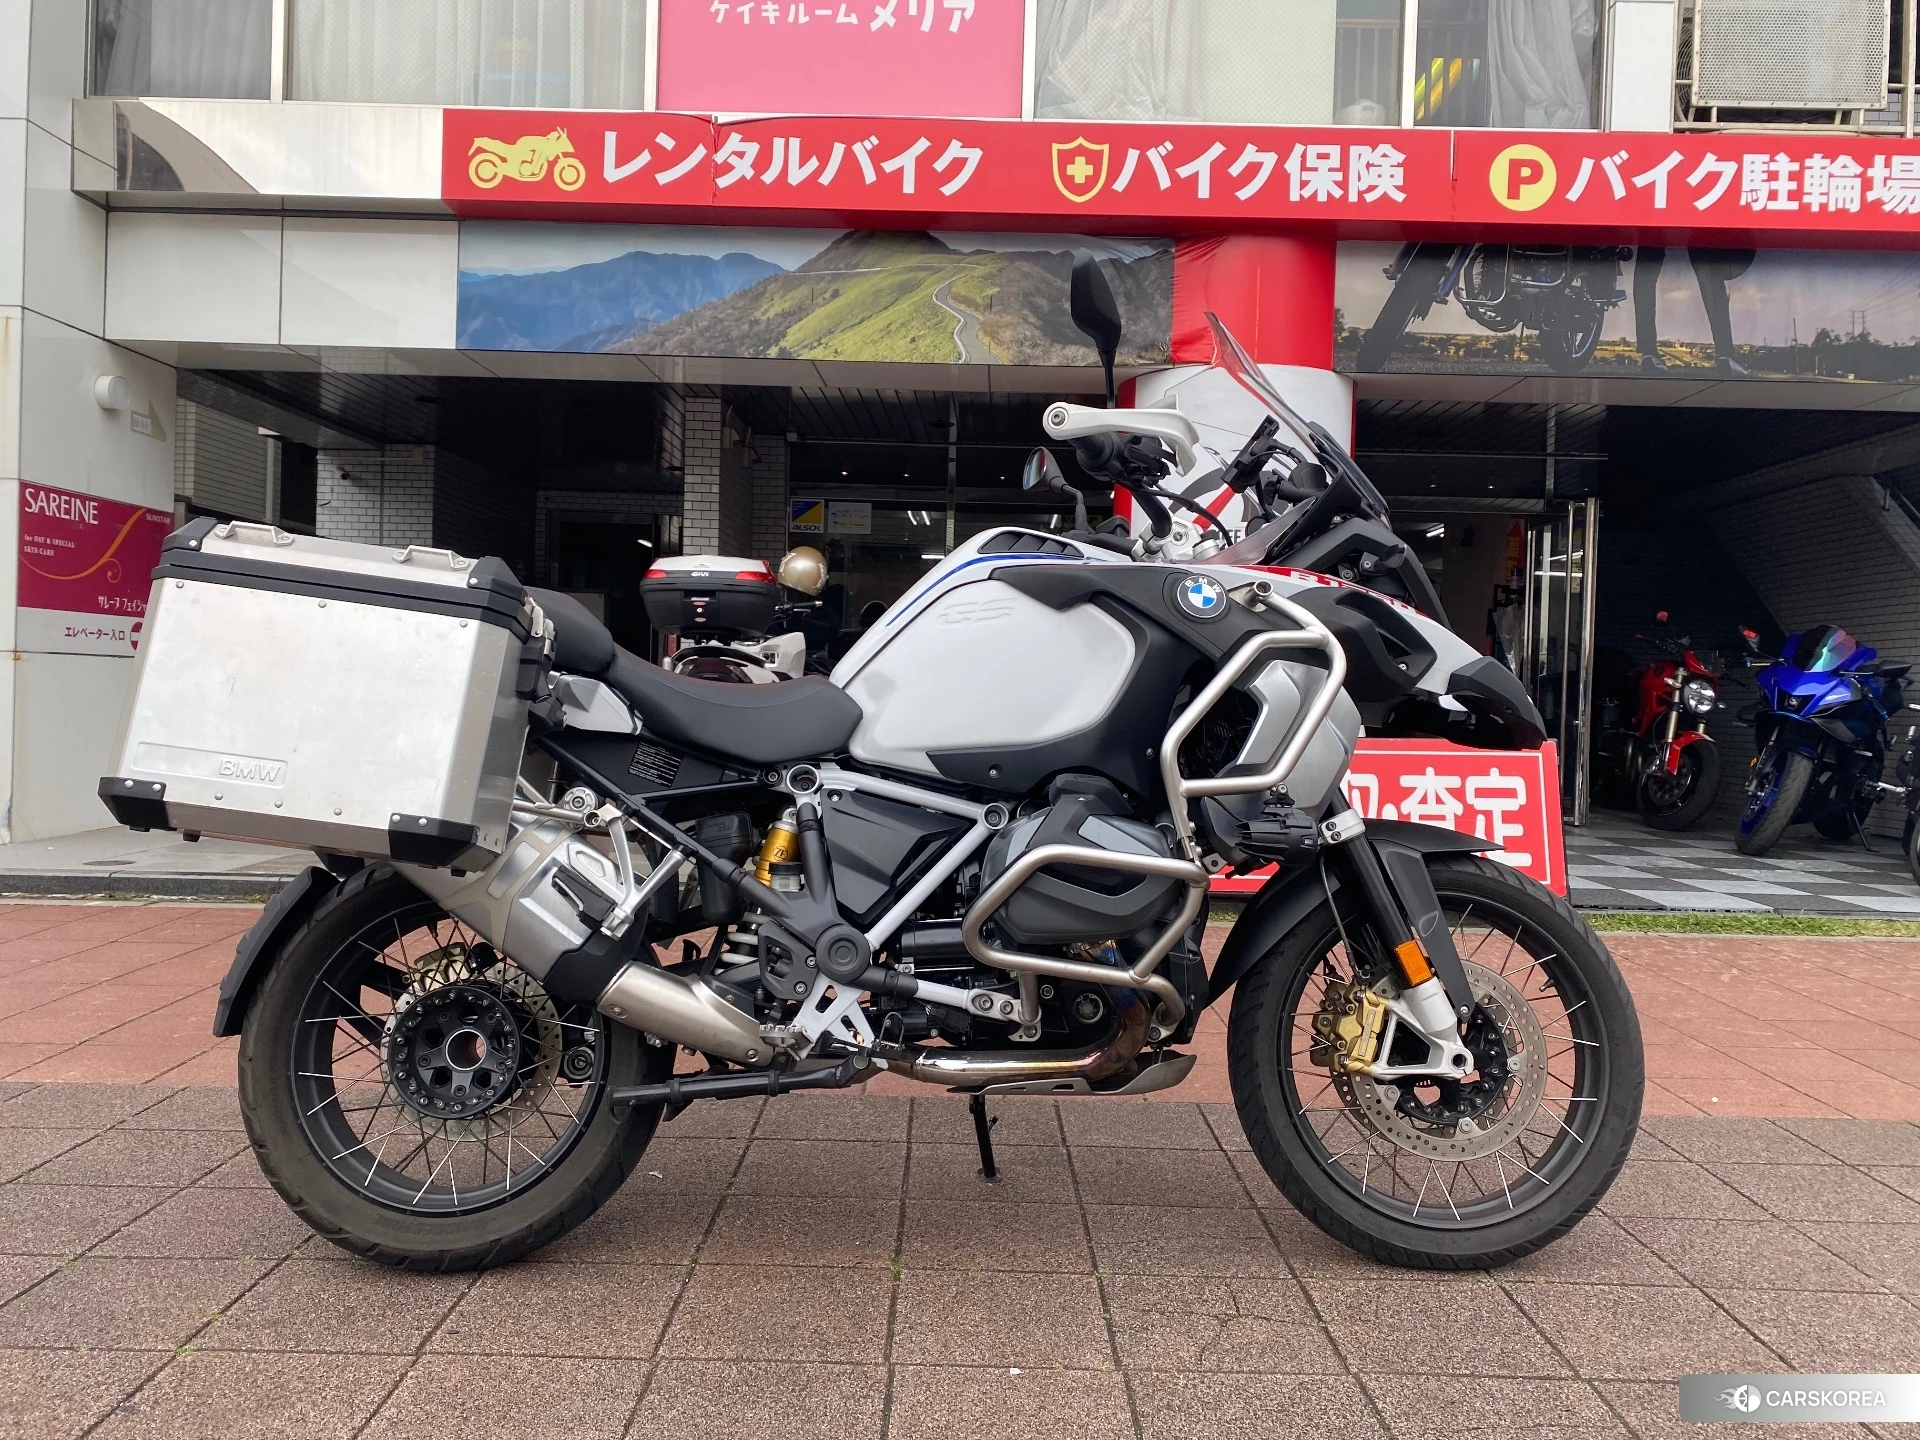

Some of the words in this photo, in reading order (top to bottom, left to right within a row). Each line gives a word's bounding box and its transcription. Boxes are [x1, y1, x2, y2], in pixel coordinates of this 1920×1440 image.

[710, 0, 859, 25] ケイキルーム
[869, 0, 976, 33] メリア
[603, 131, 984, 197] レンタルバイク
[1111, 141, 1408, 203] バイク保険
[1565, 149, 1920, 214] バイク駐輪場
[24, 488, 99, 525] SAREINE
[145, 513, 171, 525] SUNSTAR
[24, 545, 38, 554] SKIN
[39, 547, 55, 557] CARE
[34, 535, 45, 544] DAY
[52, 538, 75, 549] SPECIAL
[1184, 577, 1221, 593] BMW
[64, 626, 125, 641] エレベーター入口
[219, 758, 281, 782] BMW
[773, 847, 789, 860] ZF
